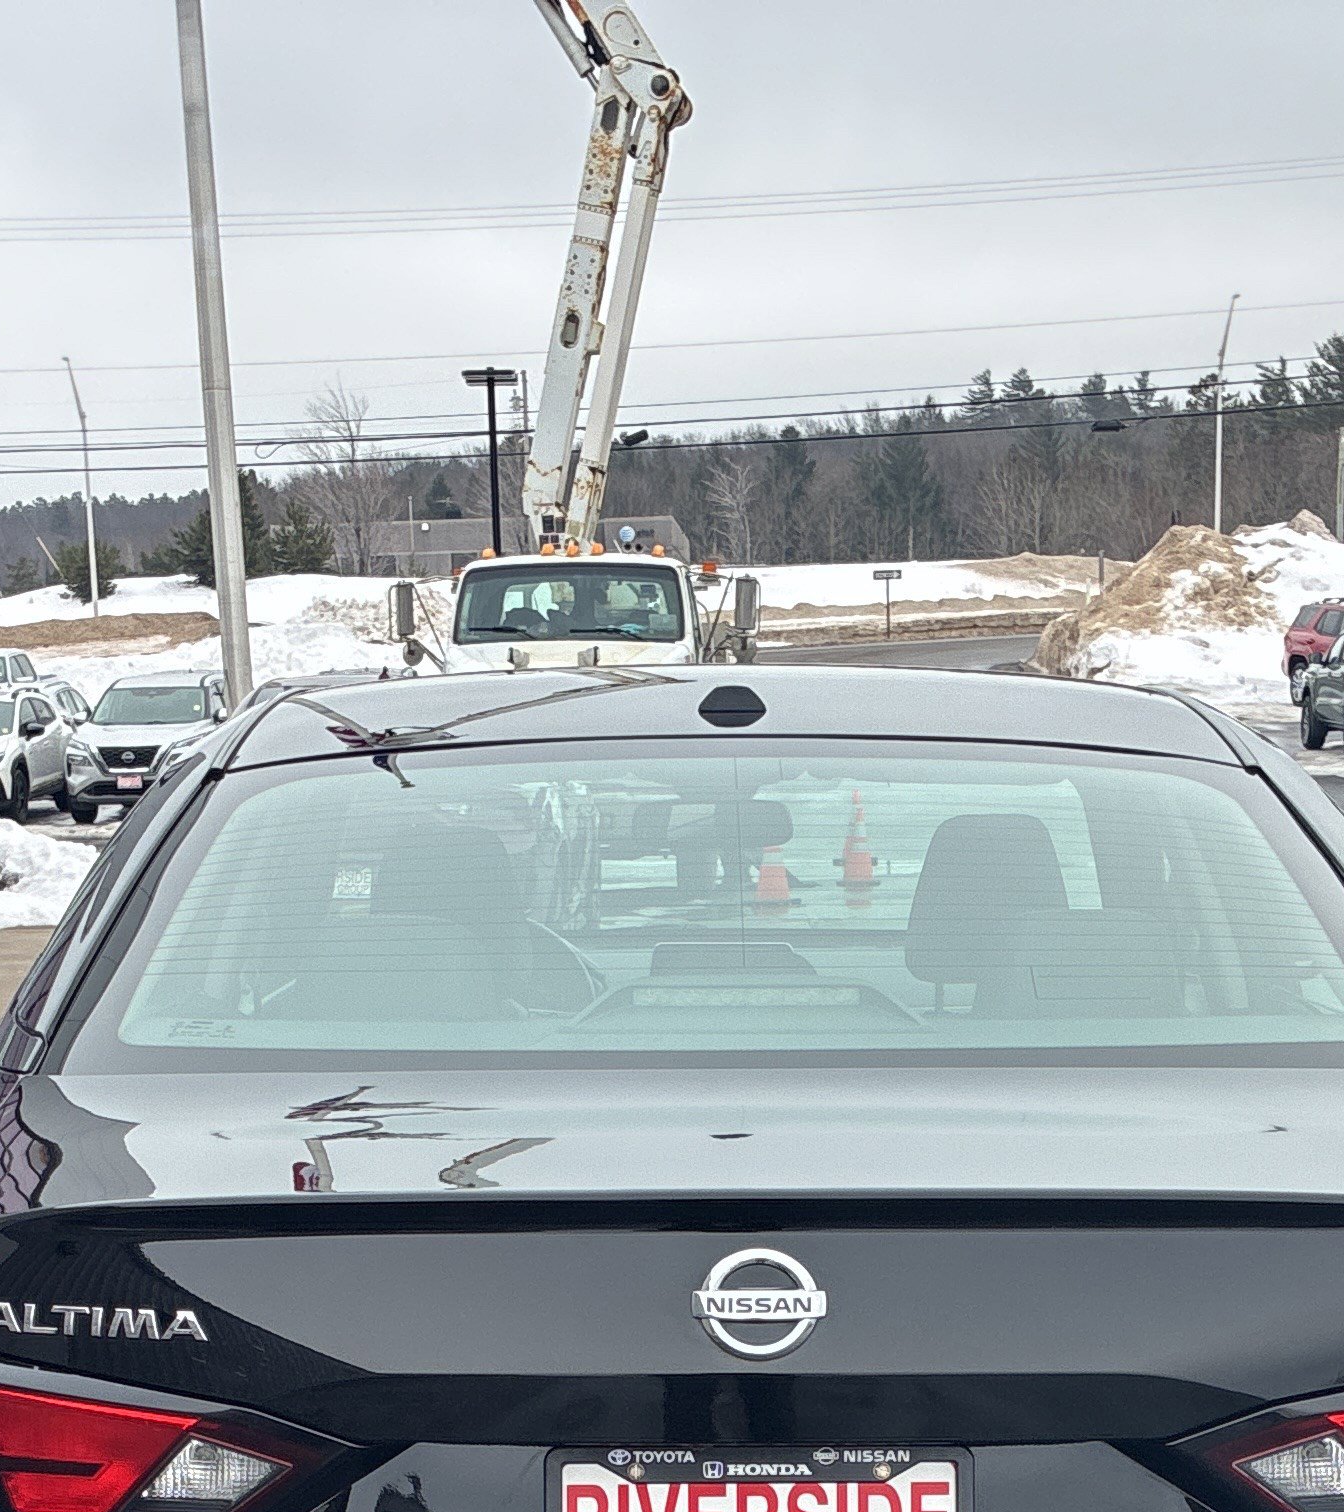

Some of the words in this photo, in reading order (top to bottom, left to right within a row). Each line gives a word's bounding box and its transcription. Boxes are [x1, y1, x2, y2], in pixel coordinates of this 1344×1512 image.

[706, 1297, 812, 1314] NISSAN
[632, 1450, 695, 1464] TOYOTA
[842, 1449, 911, 1463] NISSAN
[726, 1463, 813, 1477] HONDA
